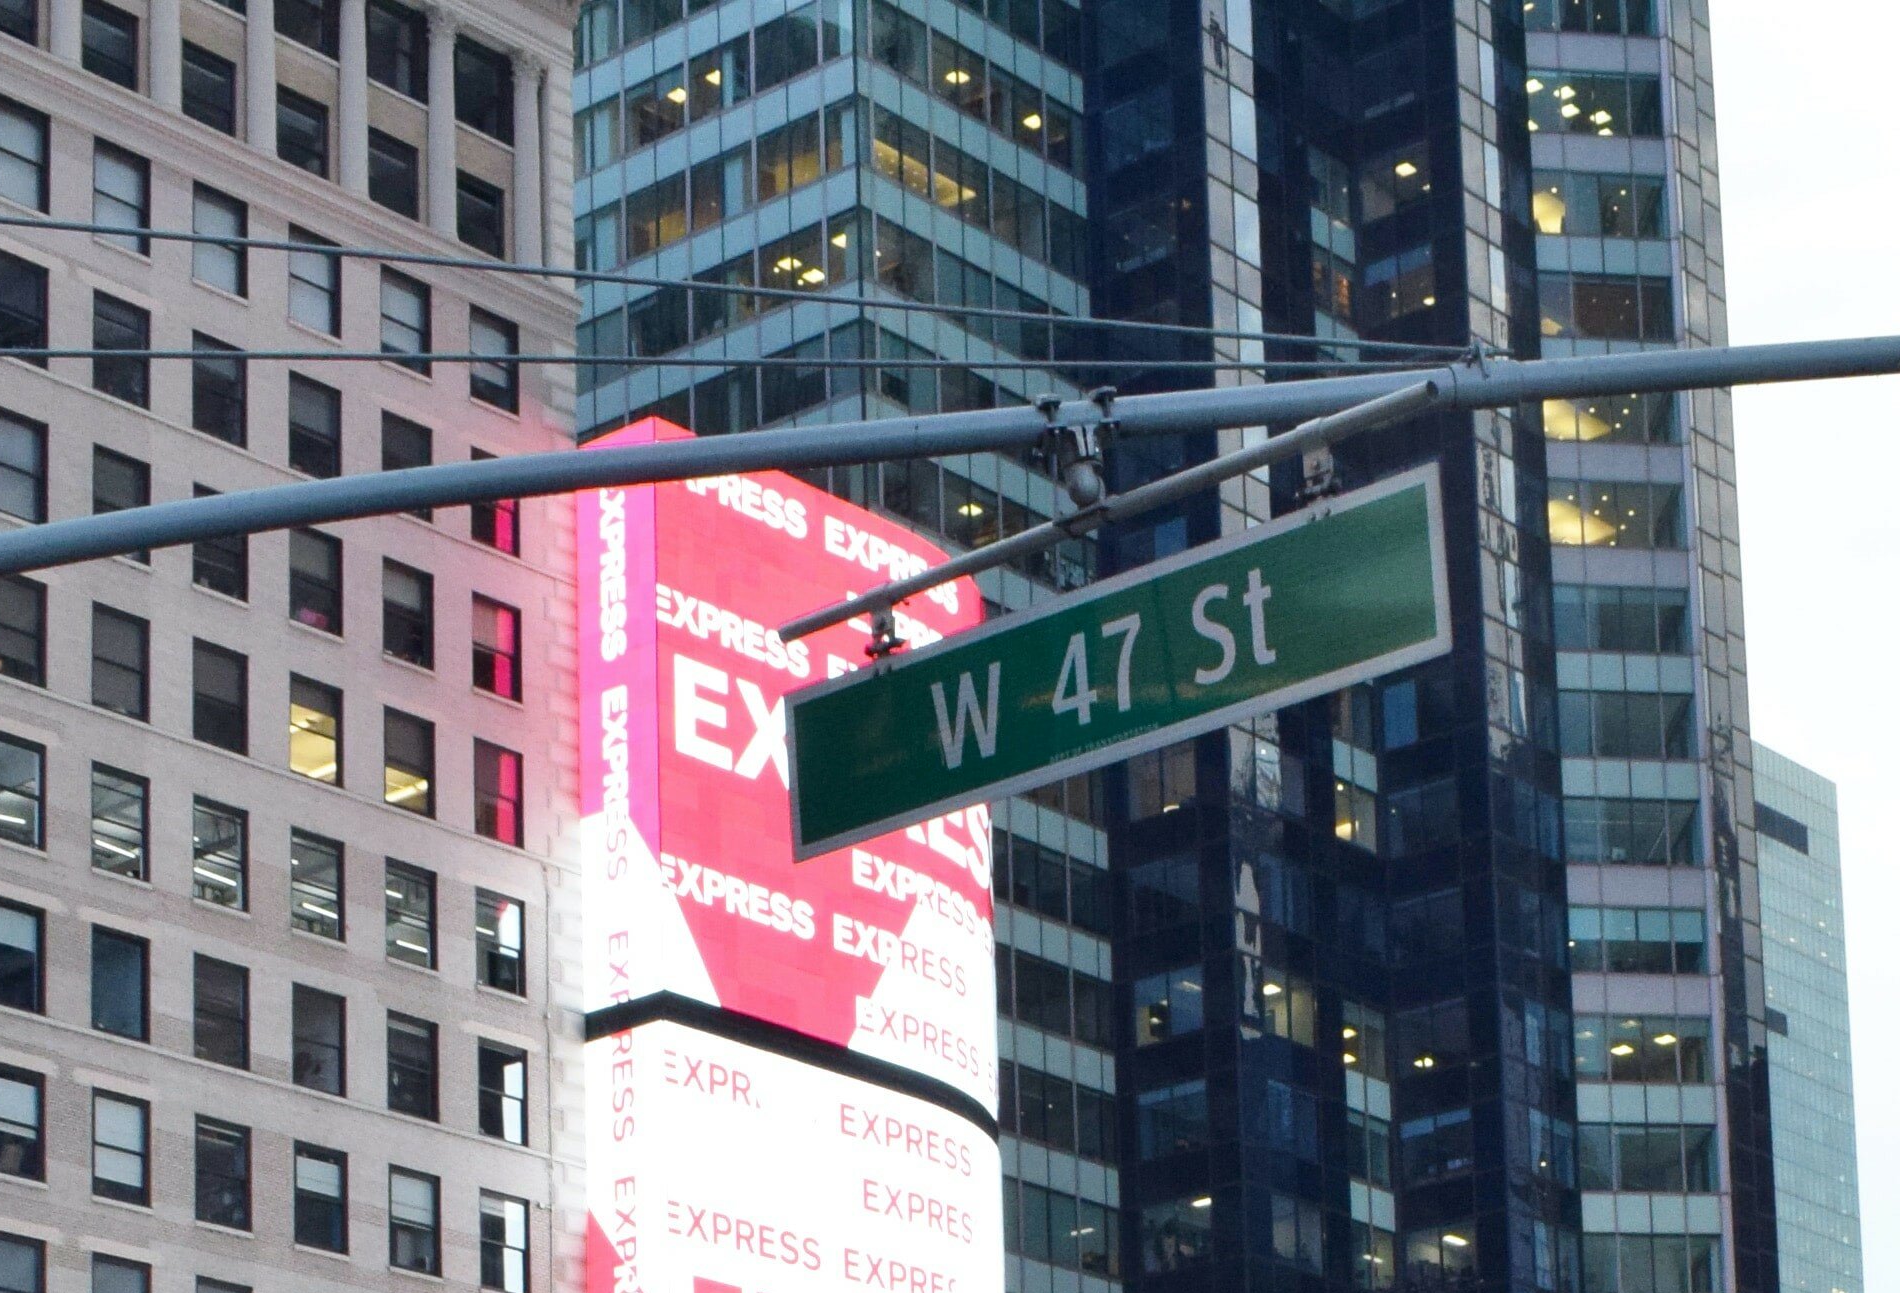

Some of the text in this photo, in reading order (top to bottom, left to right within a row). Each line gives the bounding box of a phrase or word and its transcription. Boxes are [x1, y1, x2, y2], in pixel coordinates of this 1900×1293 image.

[656, 583, 810, 680] EXPRESS
[931, 661, 1001, 772] W
[1051, 614, 1143, 727] 47
[1191, 565, 1278, 686] St
[661, 853, 966, 996] EXPRESS EXPRESS
[839, 1102, 972, 1177] EXPRESS
[668, 1200, 821, 1272] EXPRESS
